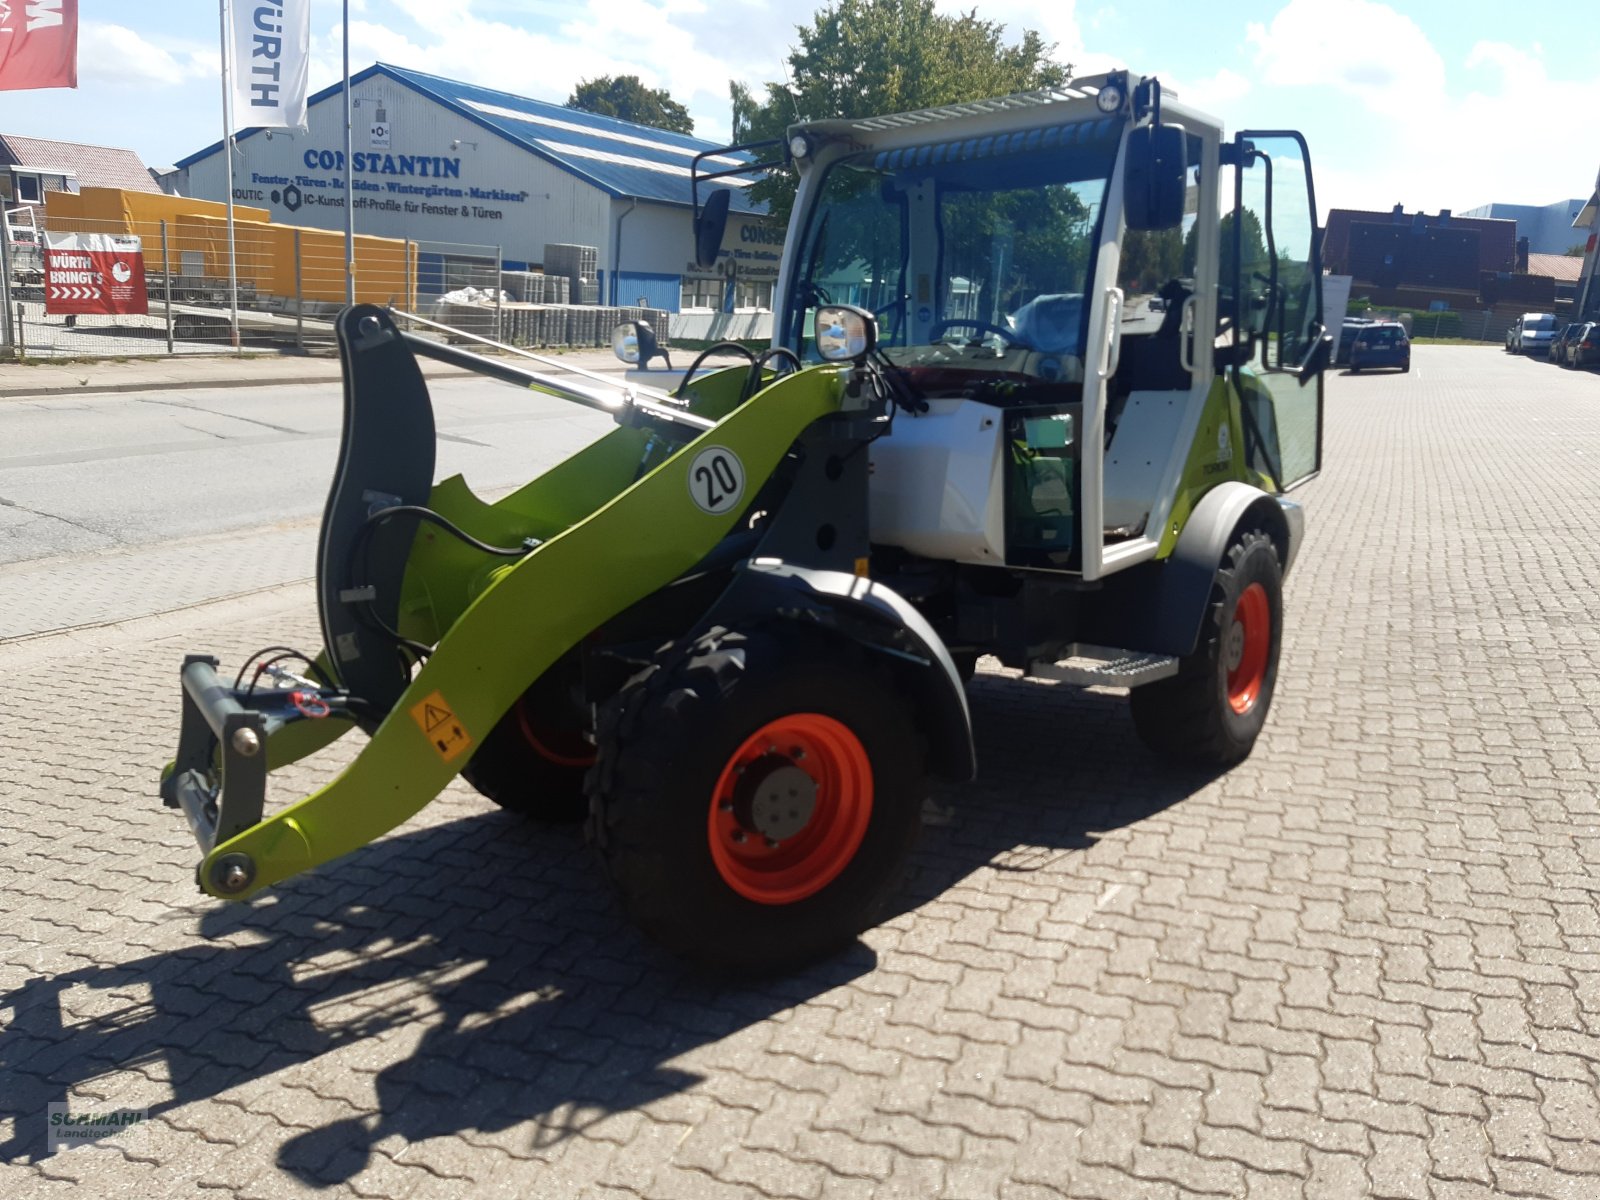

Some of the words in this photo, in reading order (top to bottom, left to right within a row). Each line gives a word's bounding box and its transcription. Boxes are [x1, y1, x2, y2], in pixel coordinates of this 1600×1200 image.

[251, 0, 284, 107] ÜRTH
[252, 173, 289, 185] Fenster
[296, 176, 327, 187] Türen
[386, 182, 463, 198] Wintergärten
[405, 201, 418, 213] für
[422, 203, 458, 216] Fenster
[461, 205, 470, 217] &
[472, 207, 502, 219] Türen
[49, 253, 92, 268] WÜRTH
[50, 271, 104, 284] BRINGT'S
[695, 456, 737, 507] 20
